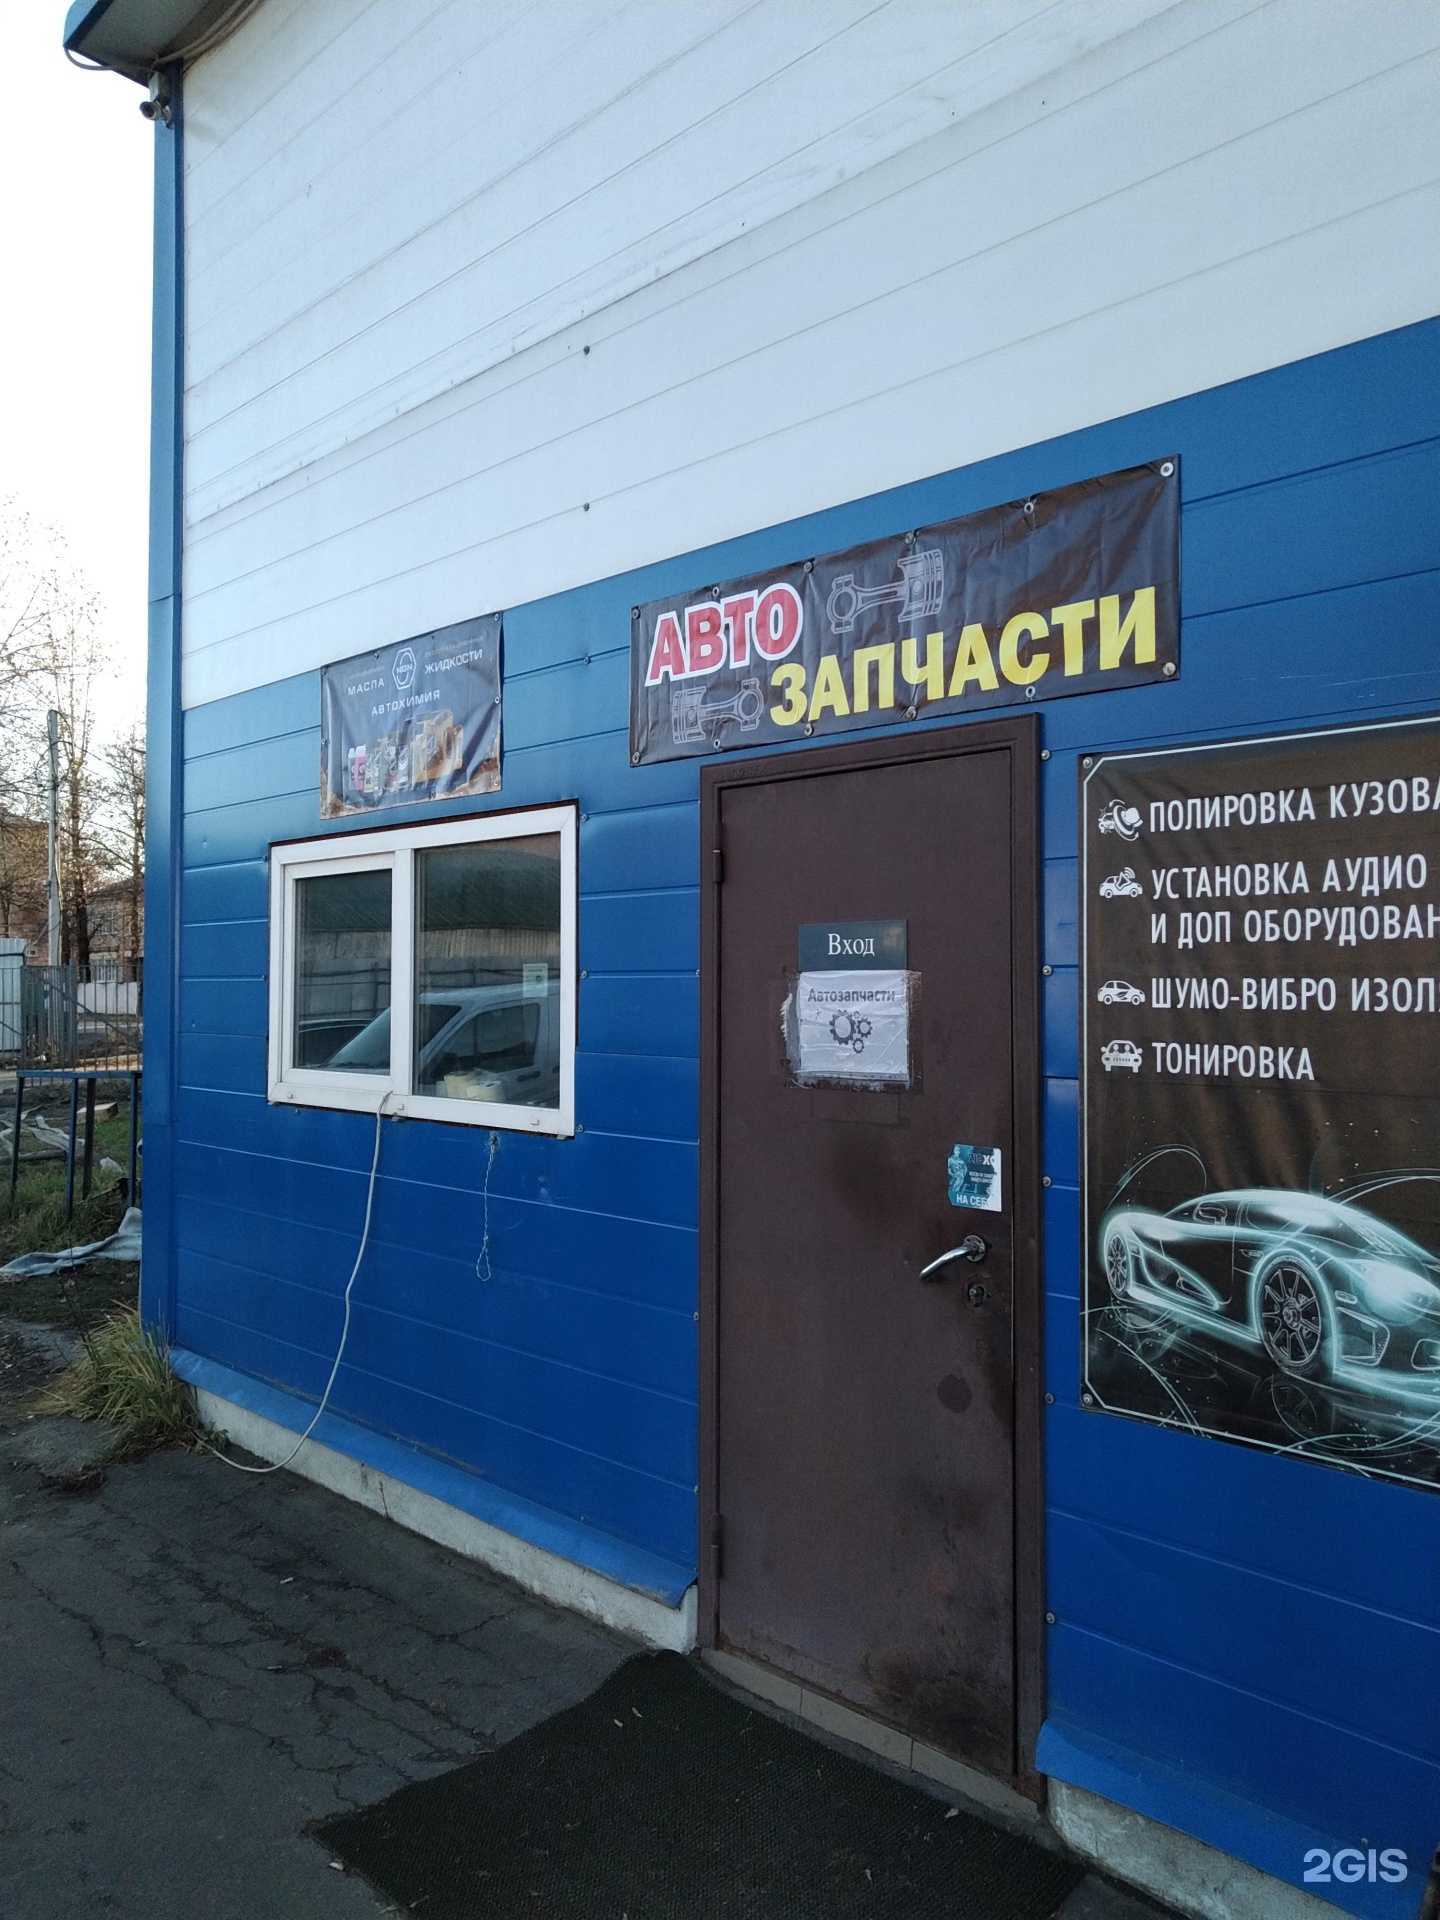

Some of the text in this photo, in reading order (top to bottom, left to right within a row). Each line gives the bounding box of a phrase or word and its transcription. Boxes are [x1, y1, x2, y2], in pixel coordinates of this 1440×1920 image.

[645, 582, 803, 687] АВТО
[347, 648, 483, 696] МАСЛА ЖИДКОСТИ
[769, 586, 1157, 727] ЗАПЧАСТИ
[371, 689, 440, 717] АВТОХИМИЯ
[1150, 787, 1316, 833] ПОЛИРОВКА
[1151, 853, 1427, 900] УСТАНОВКА АУДИО
[827, 932, 876, 957] Вход
[1151, 913, 1167, 944] И
[1177, 911, 1231, 949] ДОП
[807, 988, 897, 1003] Автозапчасти
[1151, 977, 1440, 1013] ШУМО-ВИБРО ИЗОЛ
[1151, 1042, 1316, 1081] ТОНИРОВКА
[956, 1193, 969, 1205] НА
